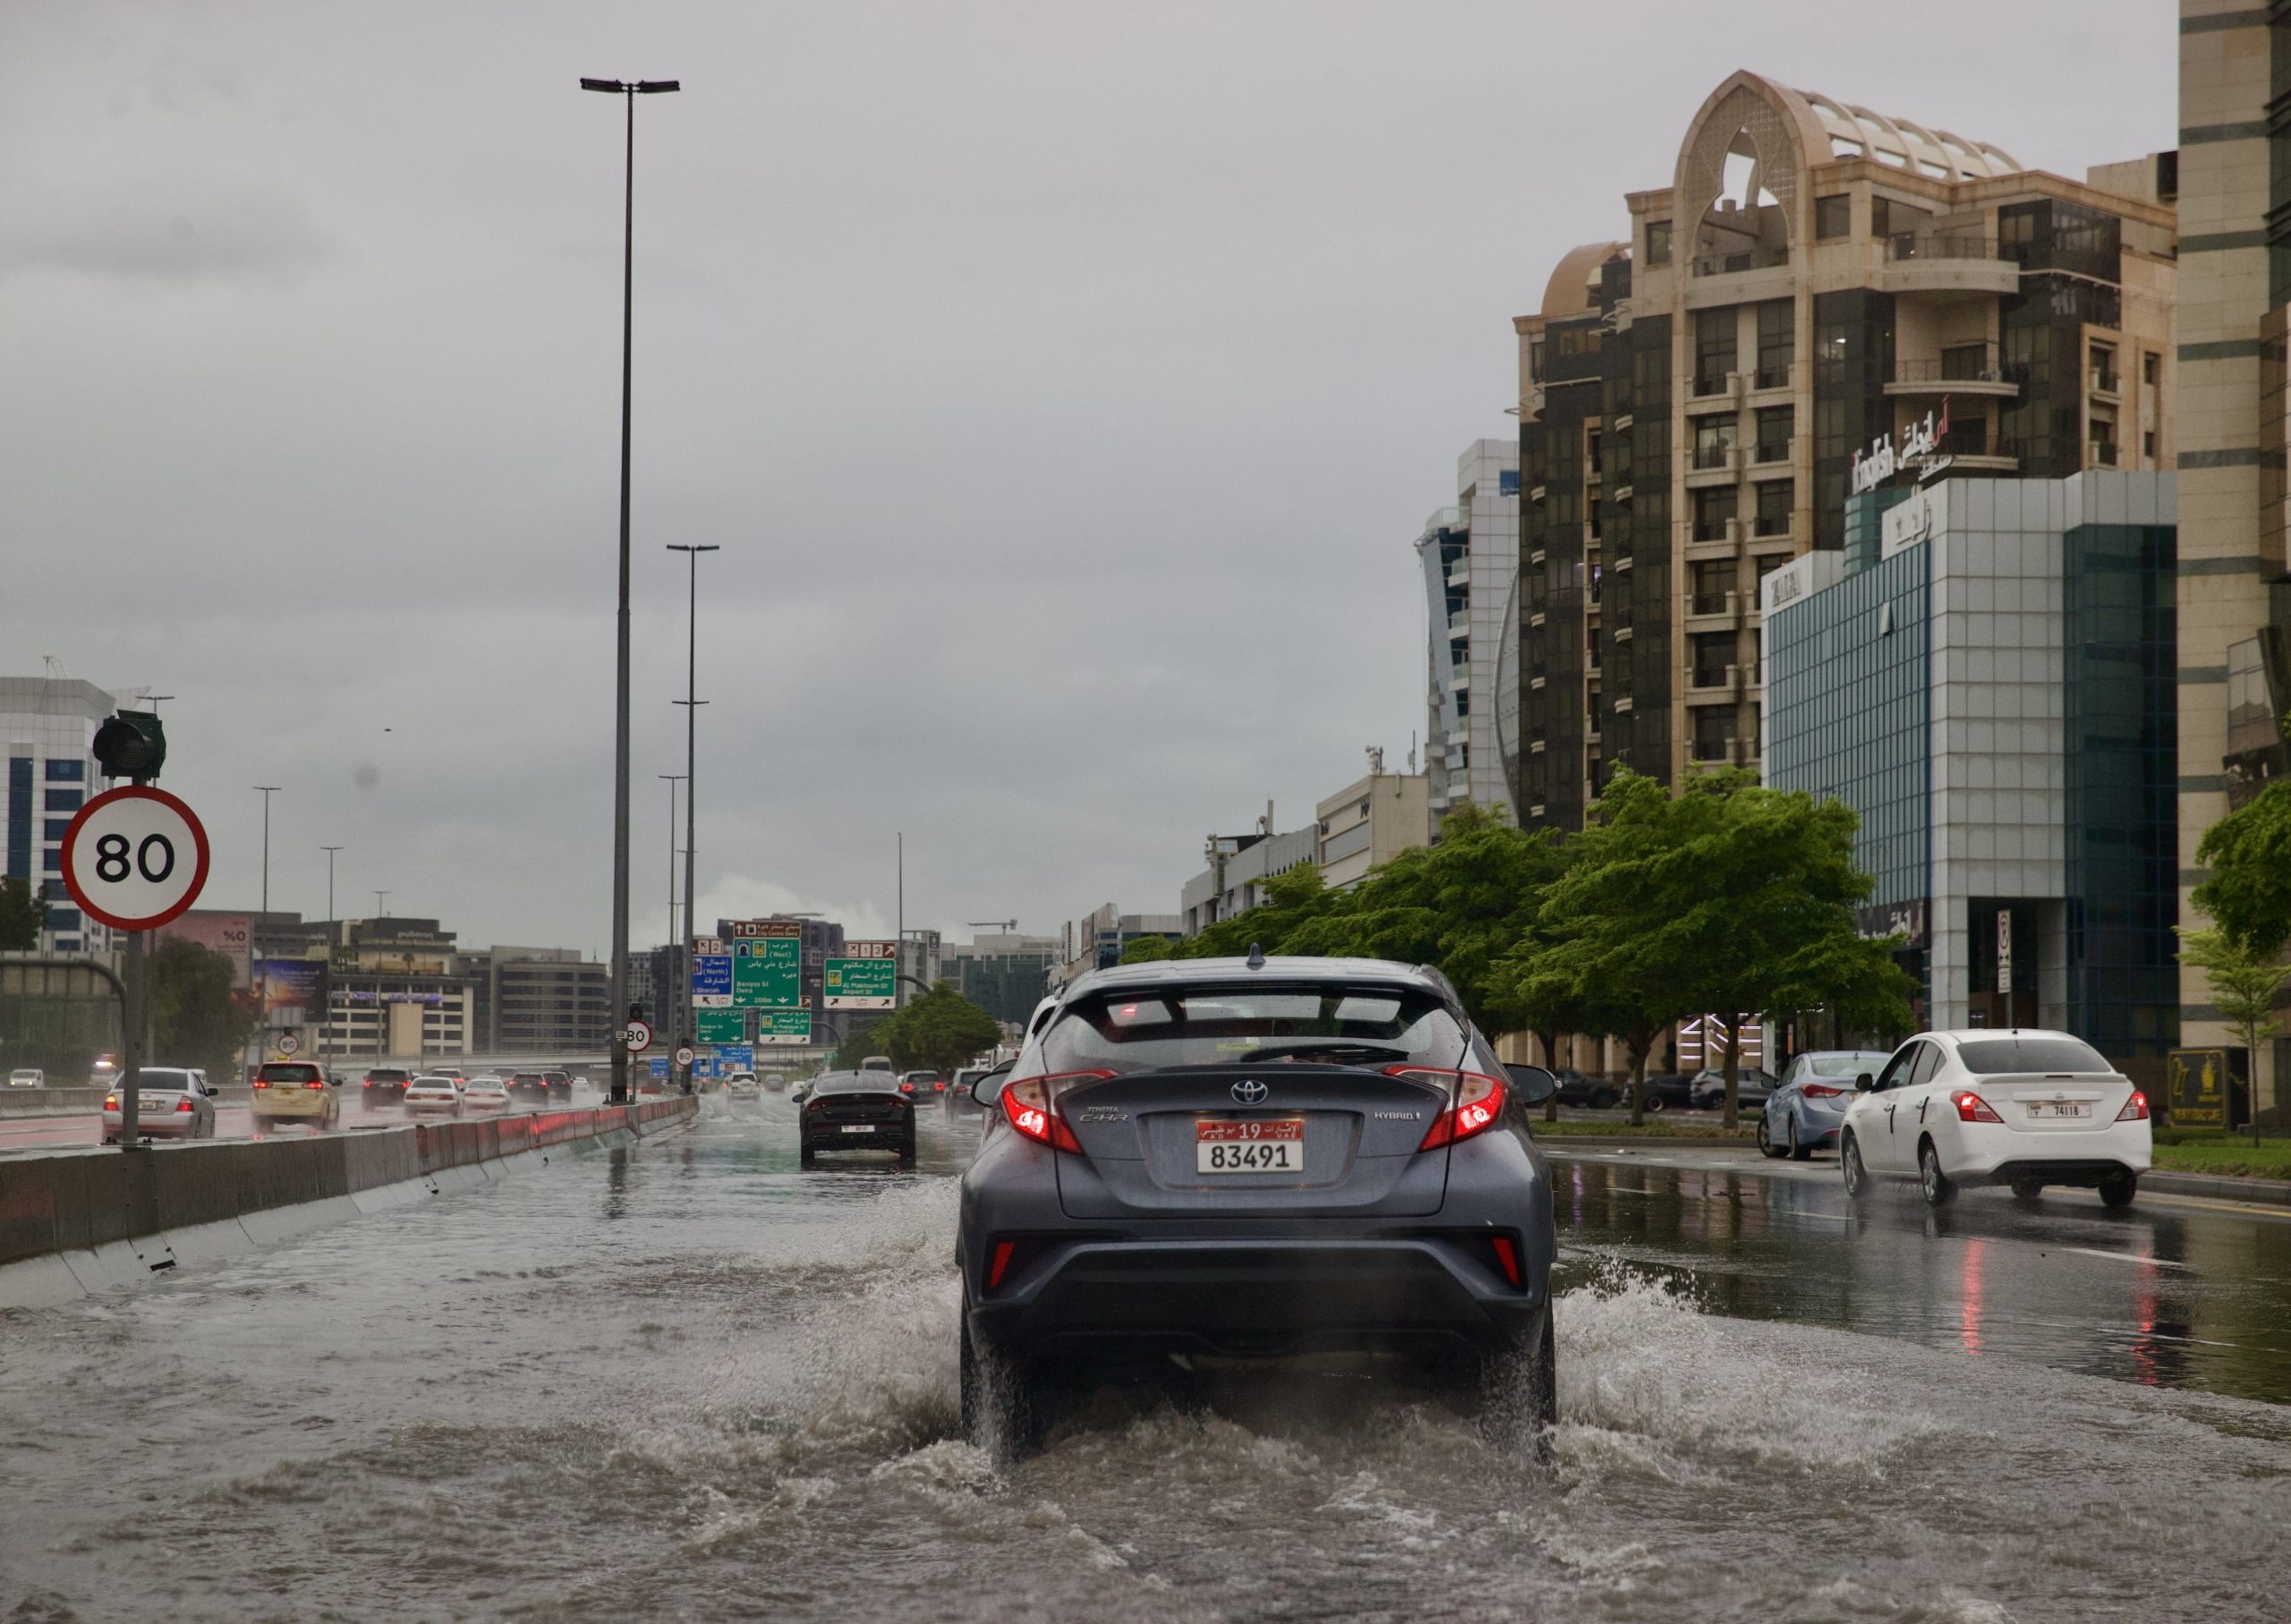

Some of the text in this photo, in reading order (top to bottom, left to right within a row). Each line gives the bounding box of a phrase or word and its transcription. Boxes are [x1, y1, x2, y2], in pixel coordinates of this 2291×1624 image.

[96, 833, 175, 883] 80
[712, 943, 720, 951] 2
[874, 947, 881, 955] 3
[779, 961, 797, 969] شارع
[627, 1031, 644, 1042] 80
[283, 1041, 294, 1049] 80
[1079, 1114, 1128, 1122] C-HR
[1374, 1111, 1413, 1119] HYBRID
[1239, 1123, 1261, 1139] 19
[1211, 1144, 1290, 1168] 83491
